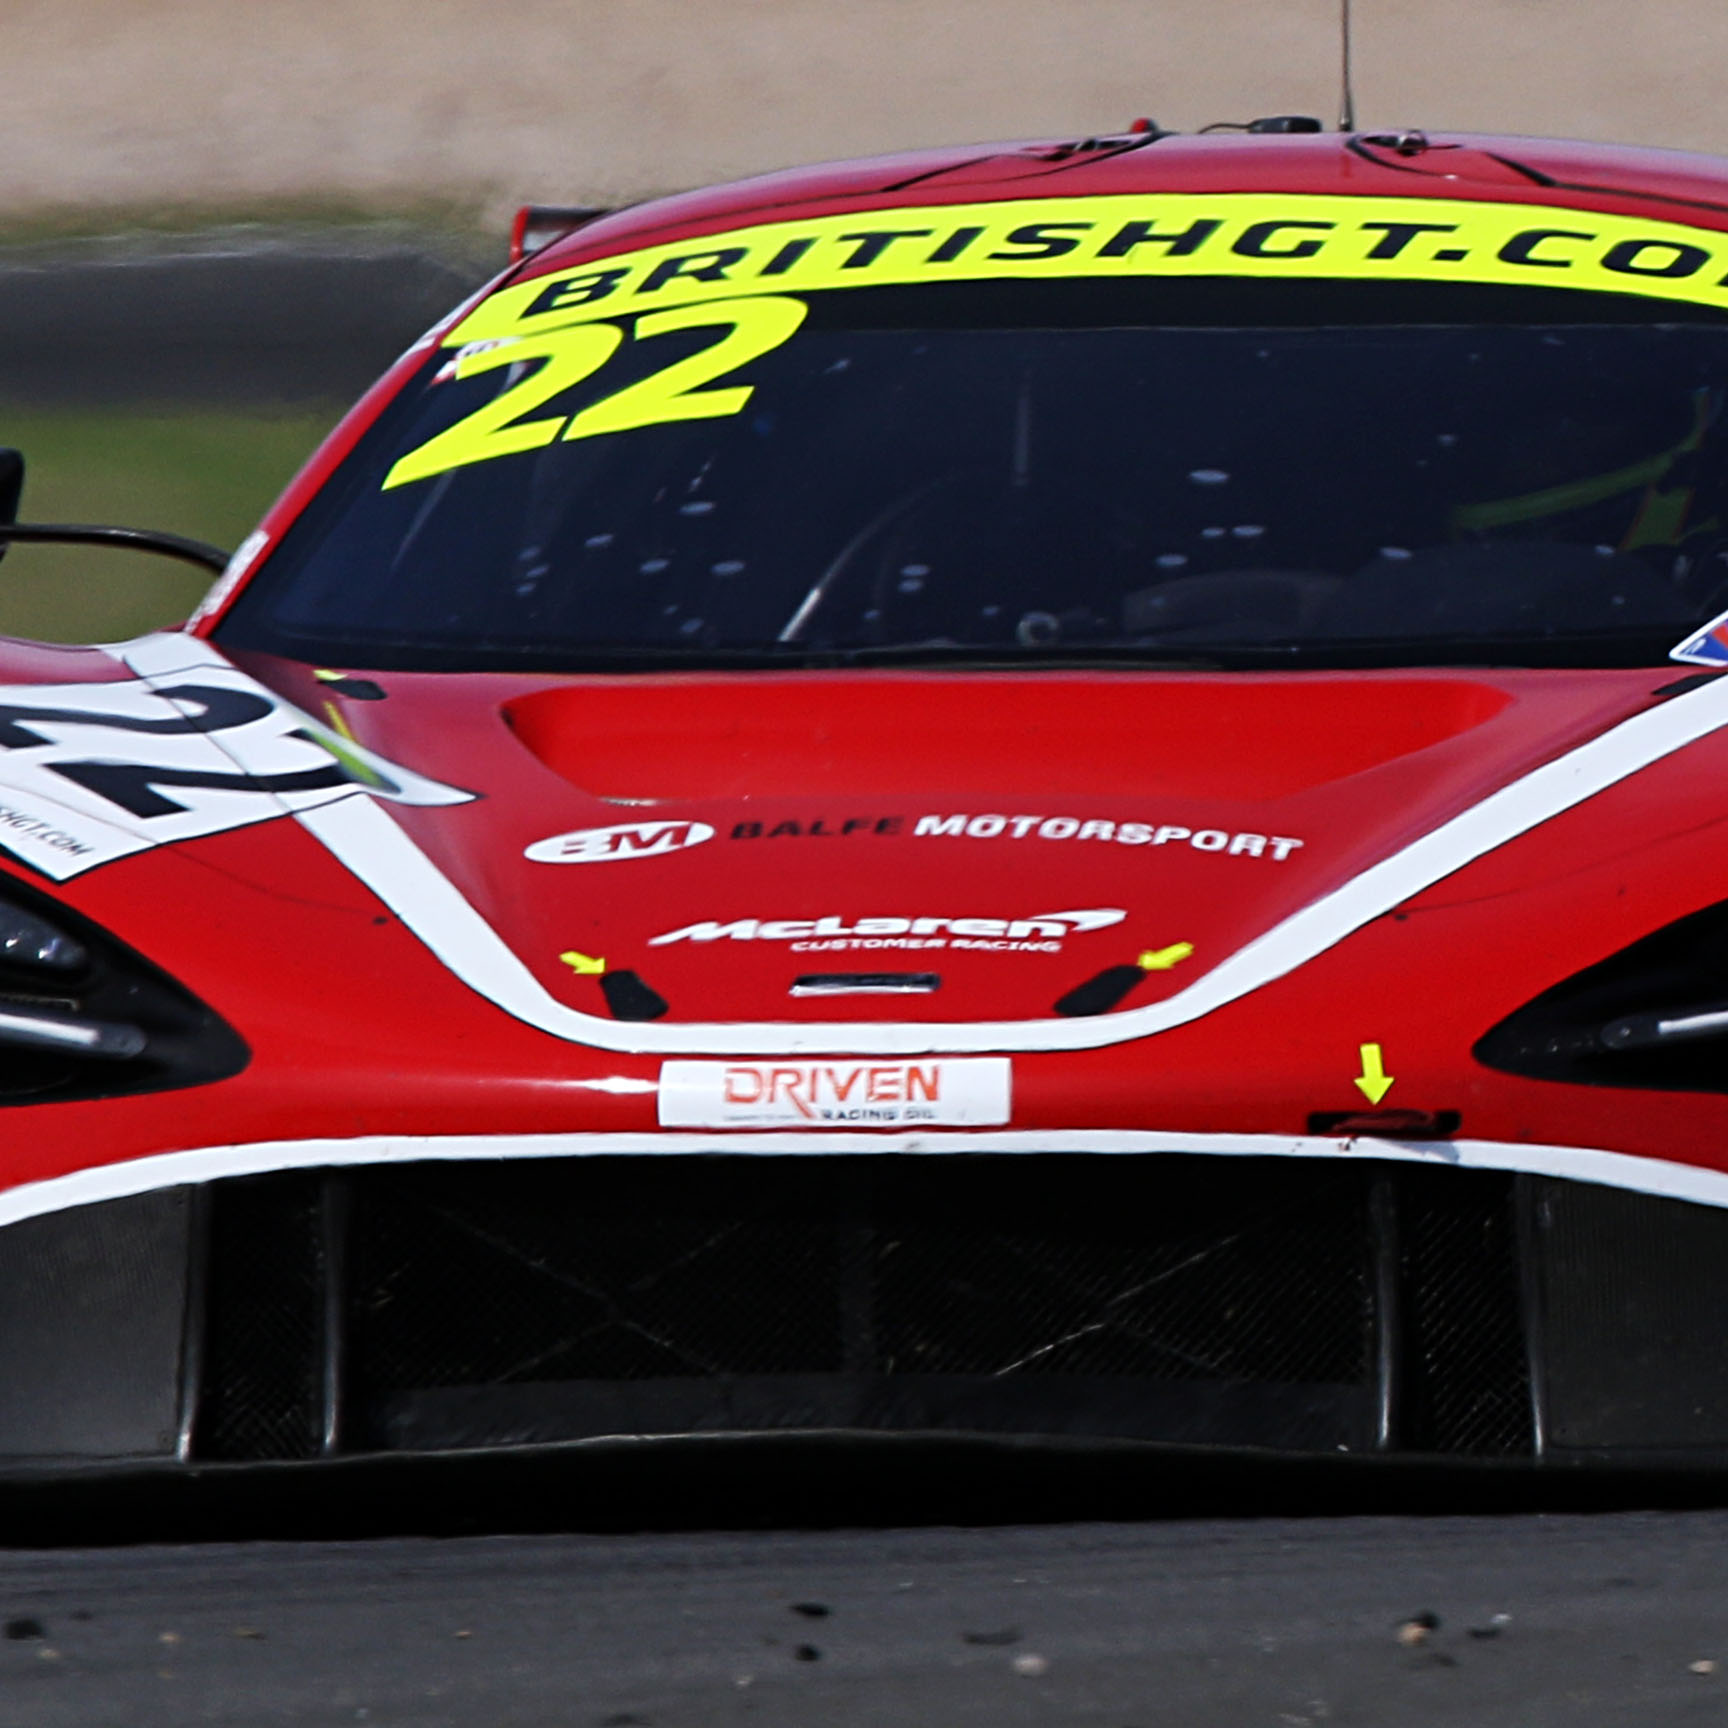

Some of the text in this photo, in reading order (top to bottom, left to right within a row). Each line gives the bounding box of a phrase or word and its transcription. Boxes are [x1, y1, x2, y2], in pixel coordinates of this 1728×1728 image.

[381, 296, 809, 491] 22
[730, 813, 1306, 862] BALFE MOTORSPORT
[648, 914, 1070, 947] McLaren
[789, 936, 1063, 954] CUSTOMER RACING
[724, 1065, 941, 1119] DRIVEN
[820, 1108, 898, 1122] RACING
